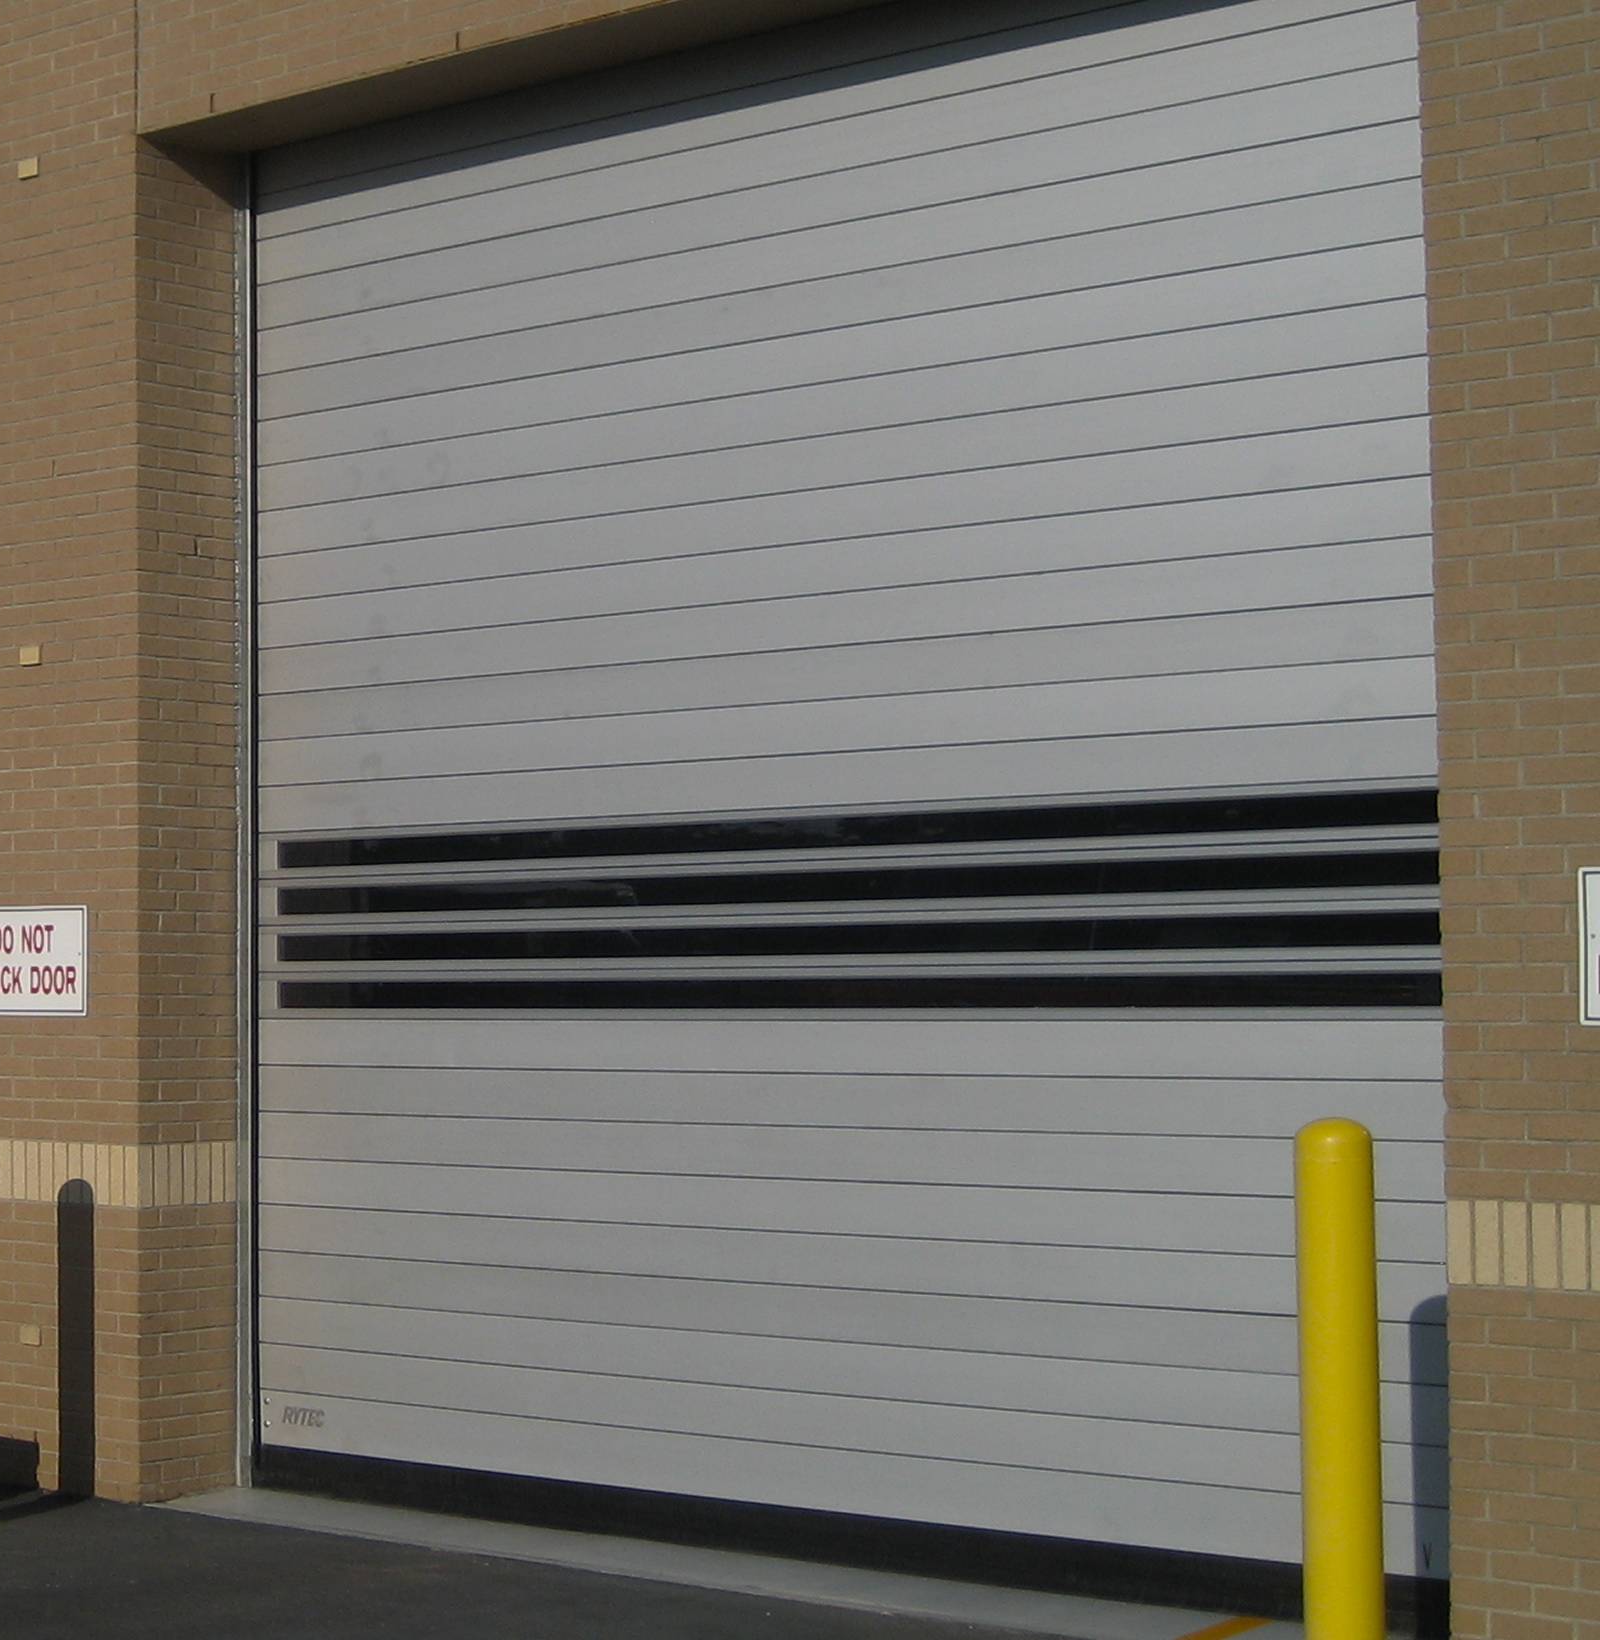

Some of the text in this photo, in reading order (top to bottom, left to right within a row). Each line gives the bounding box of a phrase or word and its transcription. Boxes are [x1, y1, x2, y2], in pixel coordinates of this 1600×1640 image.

[21, 924, 55, 954] NOT
[30, 965, 77, 995] DOOR
[282, 1405, 325, 1428] RYTEC
